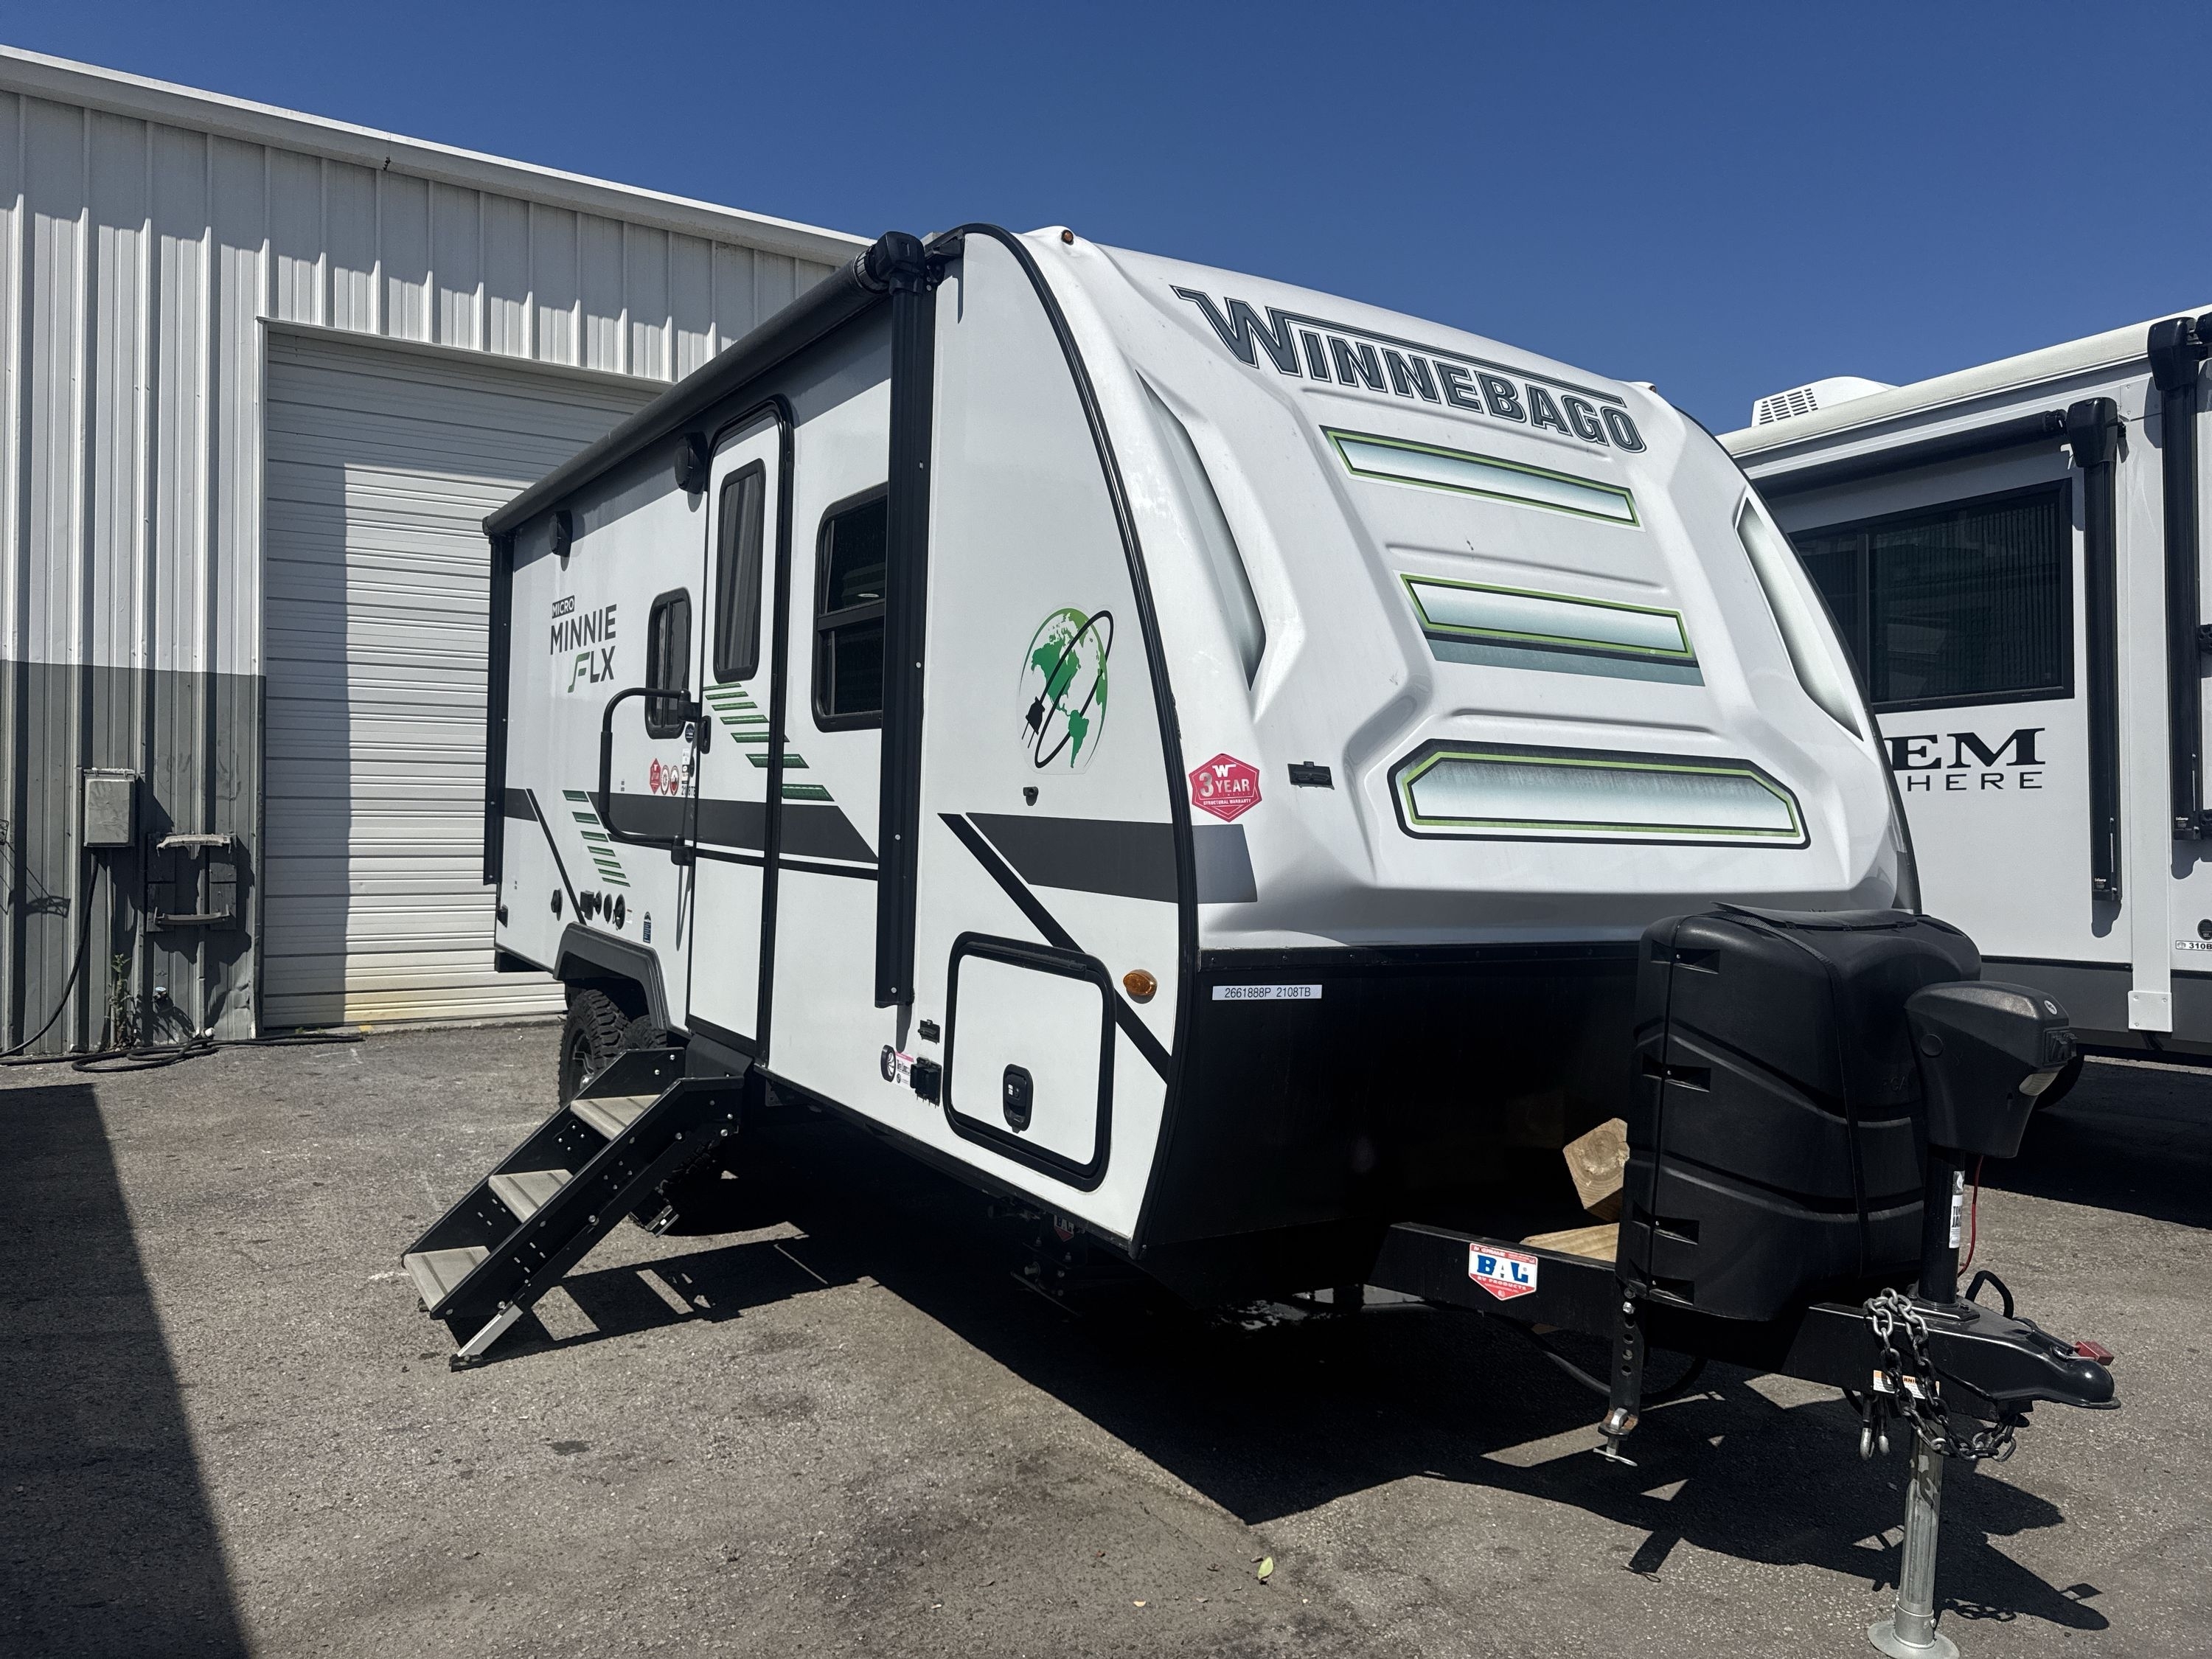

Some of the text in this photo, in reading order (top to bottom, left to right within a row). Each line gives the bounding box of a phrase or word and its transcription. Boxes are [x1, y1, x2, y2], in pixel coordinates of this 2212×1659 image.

[1170, 285, 1646, 453] WINNEBAGO
[552, 598, 574, 617] MICRO
[550, 604, 617, 655] MINNIE
[568, 645, 616, 693] FLX
[1199, 773, 1251, 797] 3 YEAR
[1907, 771, 2042, 791] HERE
[1225, 987, 1311, 998] 2661888P 2108TB
[1488, 1278, 1526, 1290] PRODUCTS
